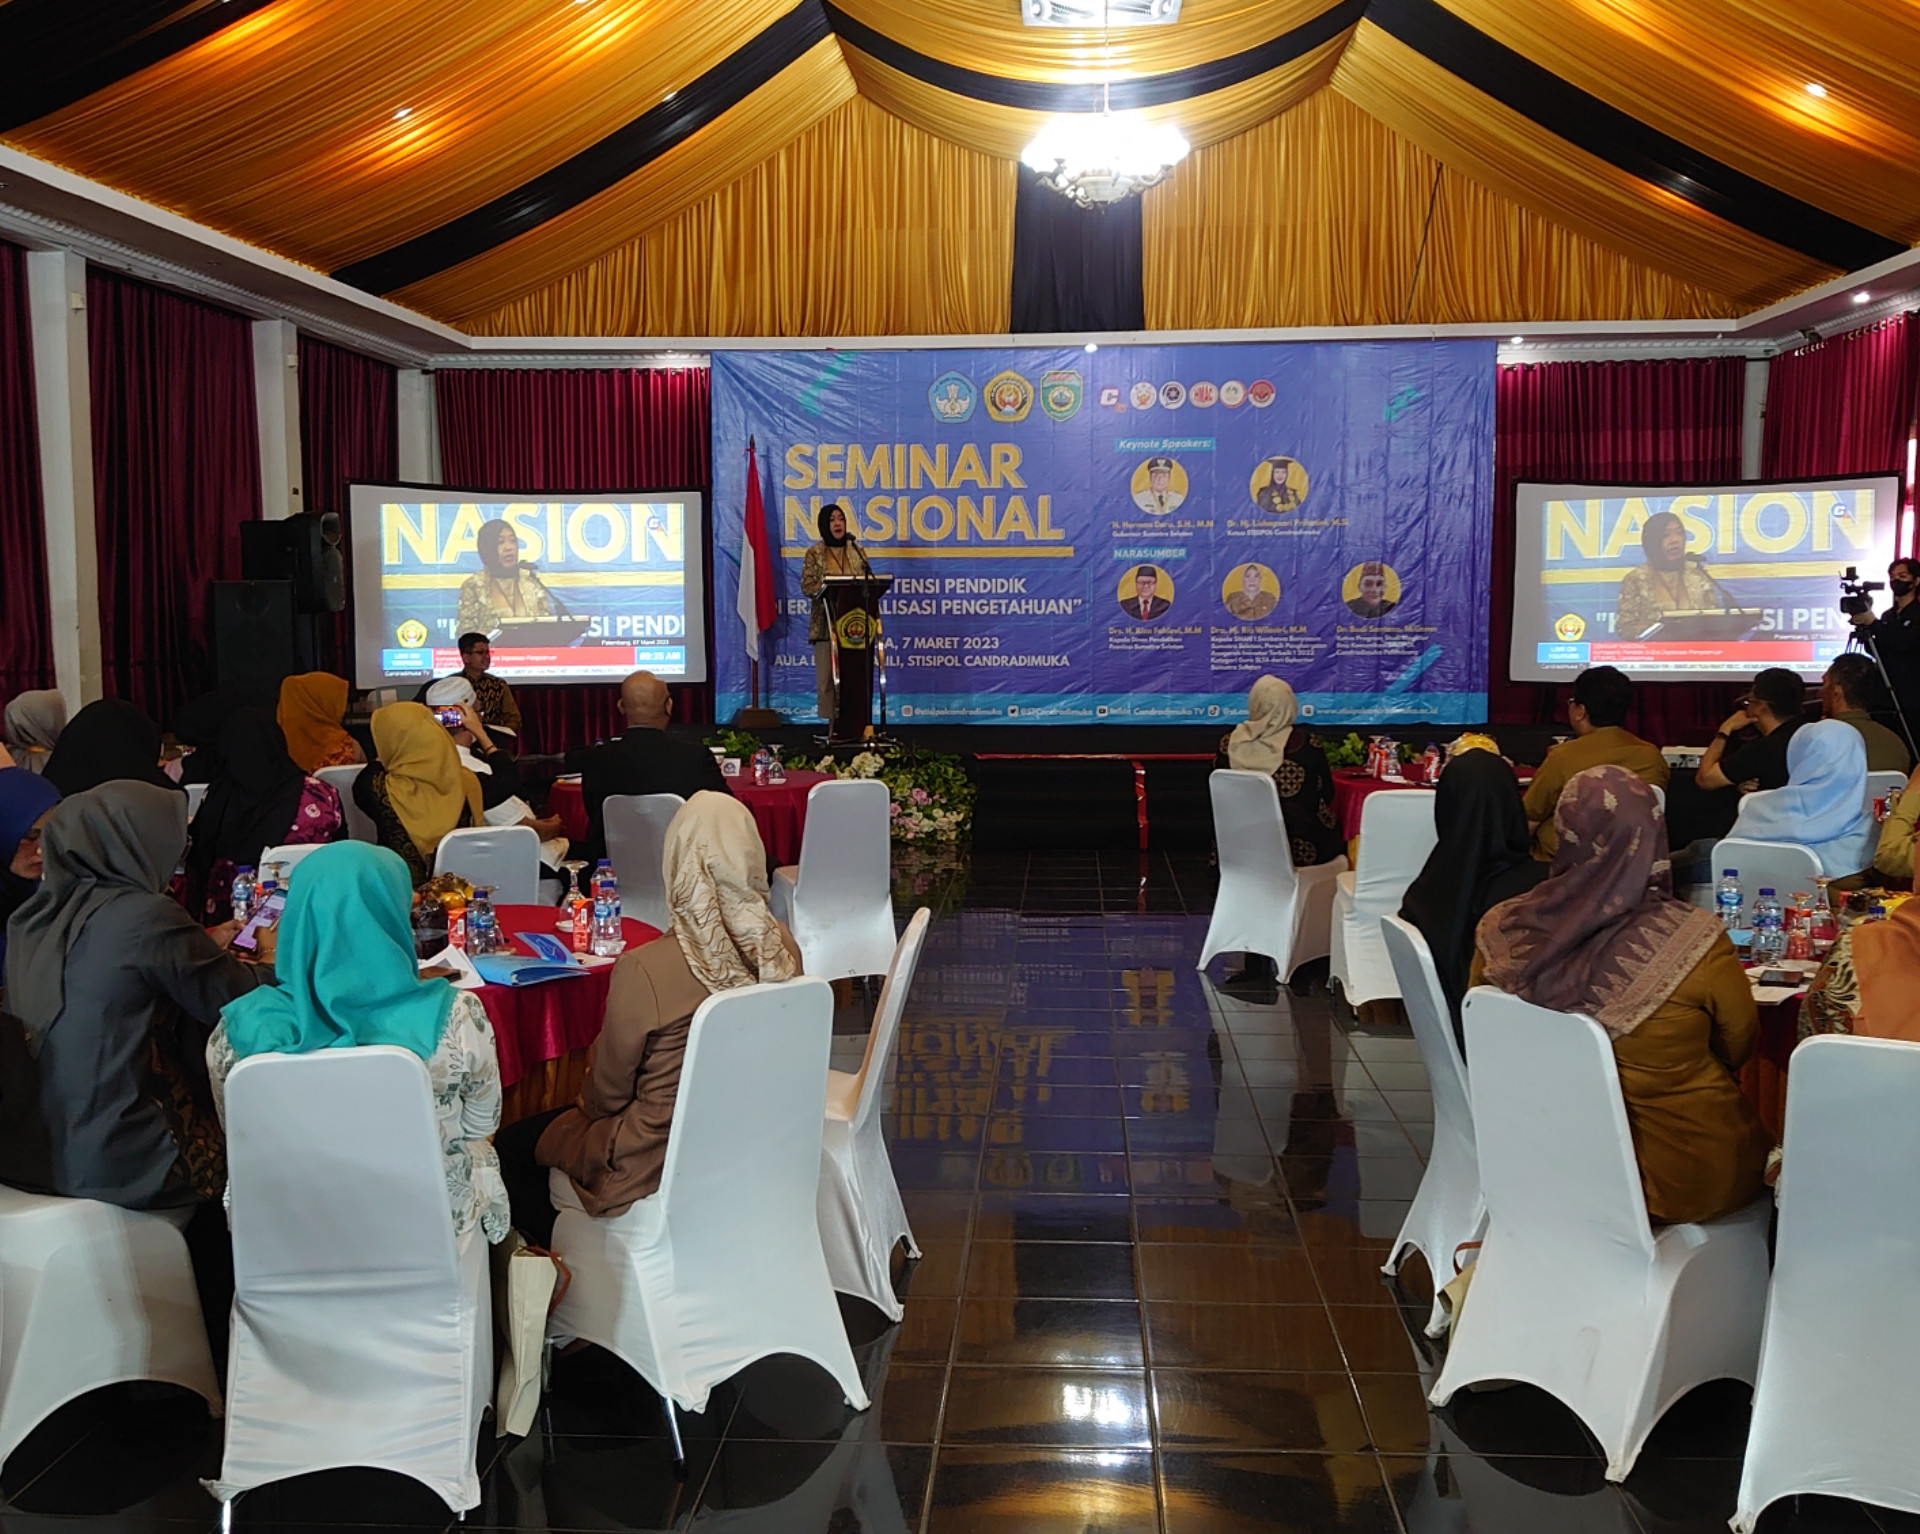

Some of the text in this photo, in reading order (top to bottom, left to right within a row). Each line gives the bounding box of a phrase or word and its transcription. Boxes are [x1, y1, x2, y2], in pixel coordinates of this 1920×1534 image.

[1119, 438, 1212, 450] Keynote Speakers:
[783, 443, 1028, 490] SEMINAR
[1114, 548, 1186, 558] NARASUMBER
[885, 578, 1027, 594] TENSI PENDIDIK
[902, 637, 911, 649] 7
[913, 637, 960, 649] MARET
[962, 637, 1000, 649] 2023
[774, 655, 808, 667] AULA
[907, 655, 961, 667] STISIPOL
[964, 655, 1070, 667] CANDRADIMUKA
